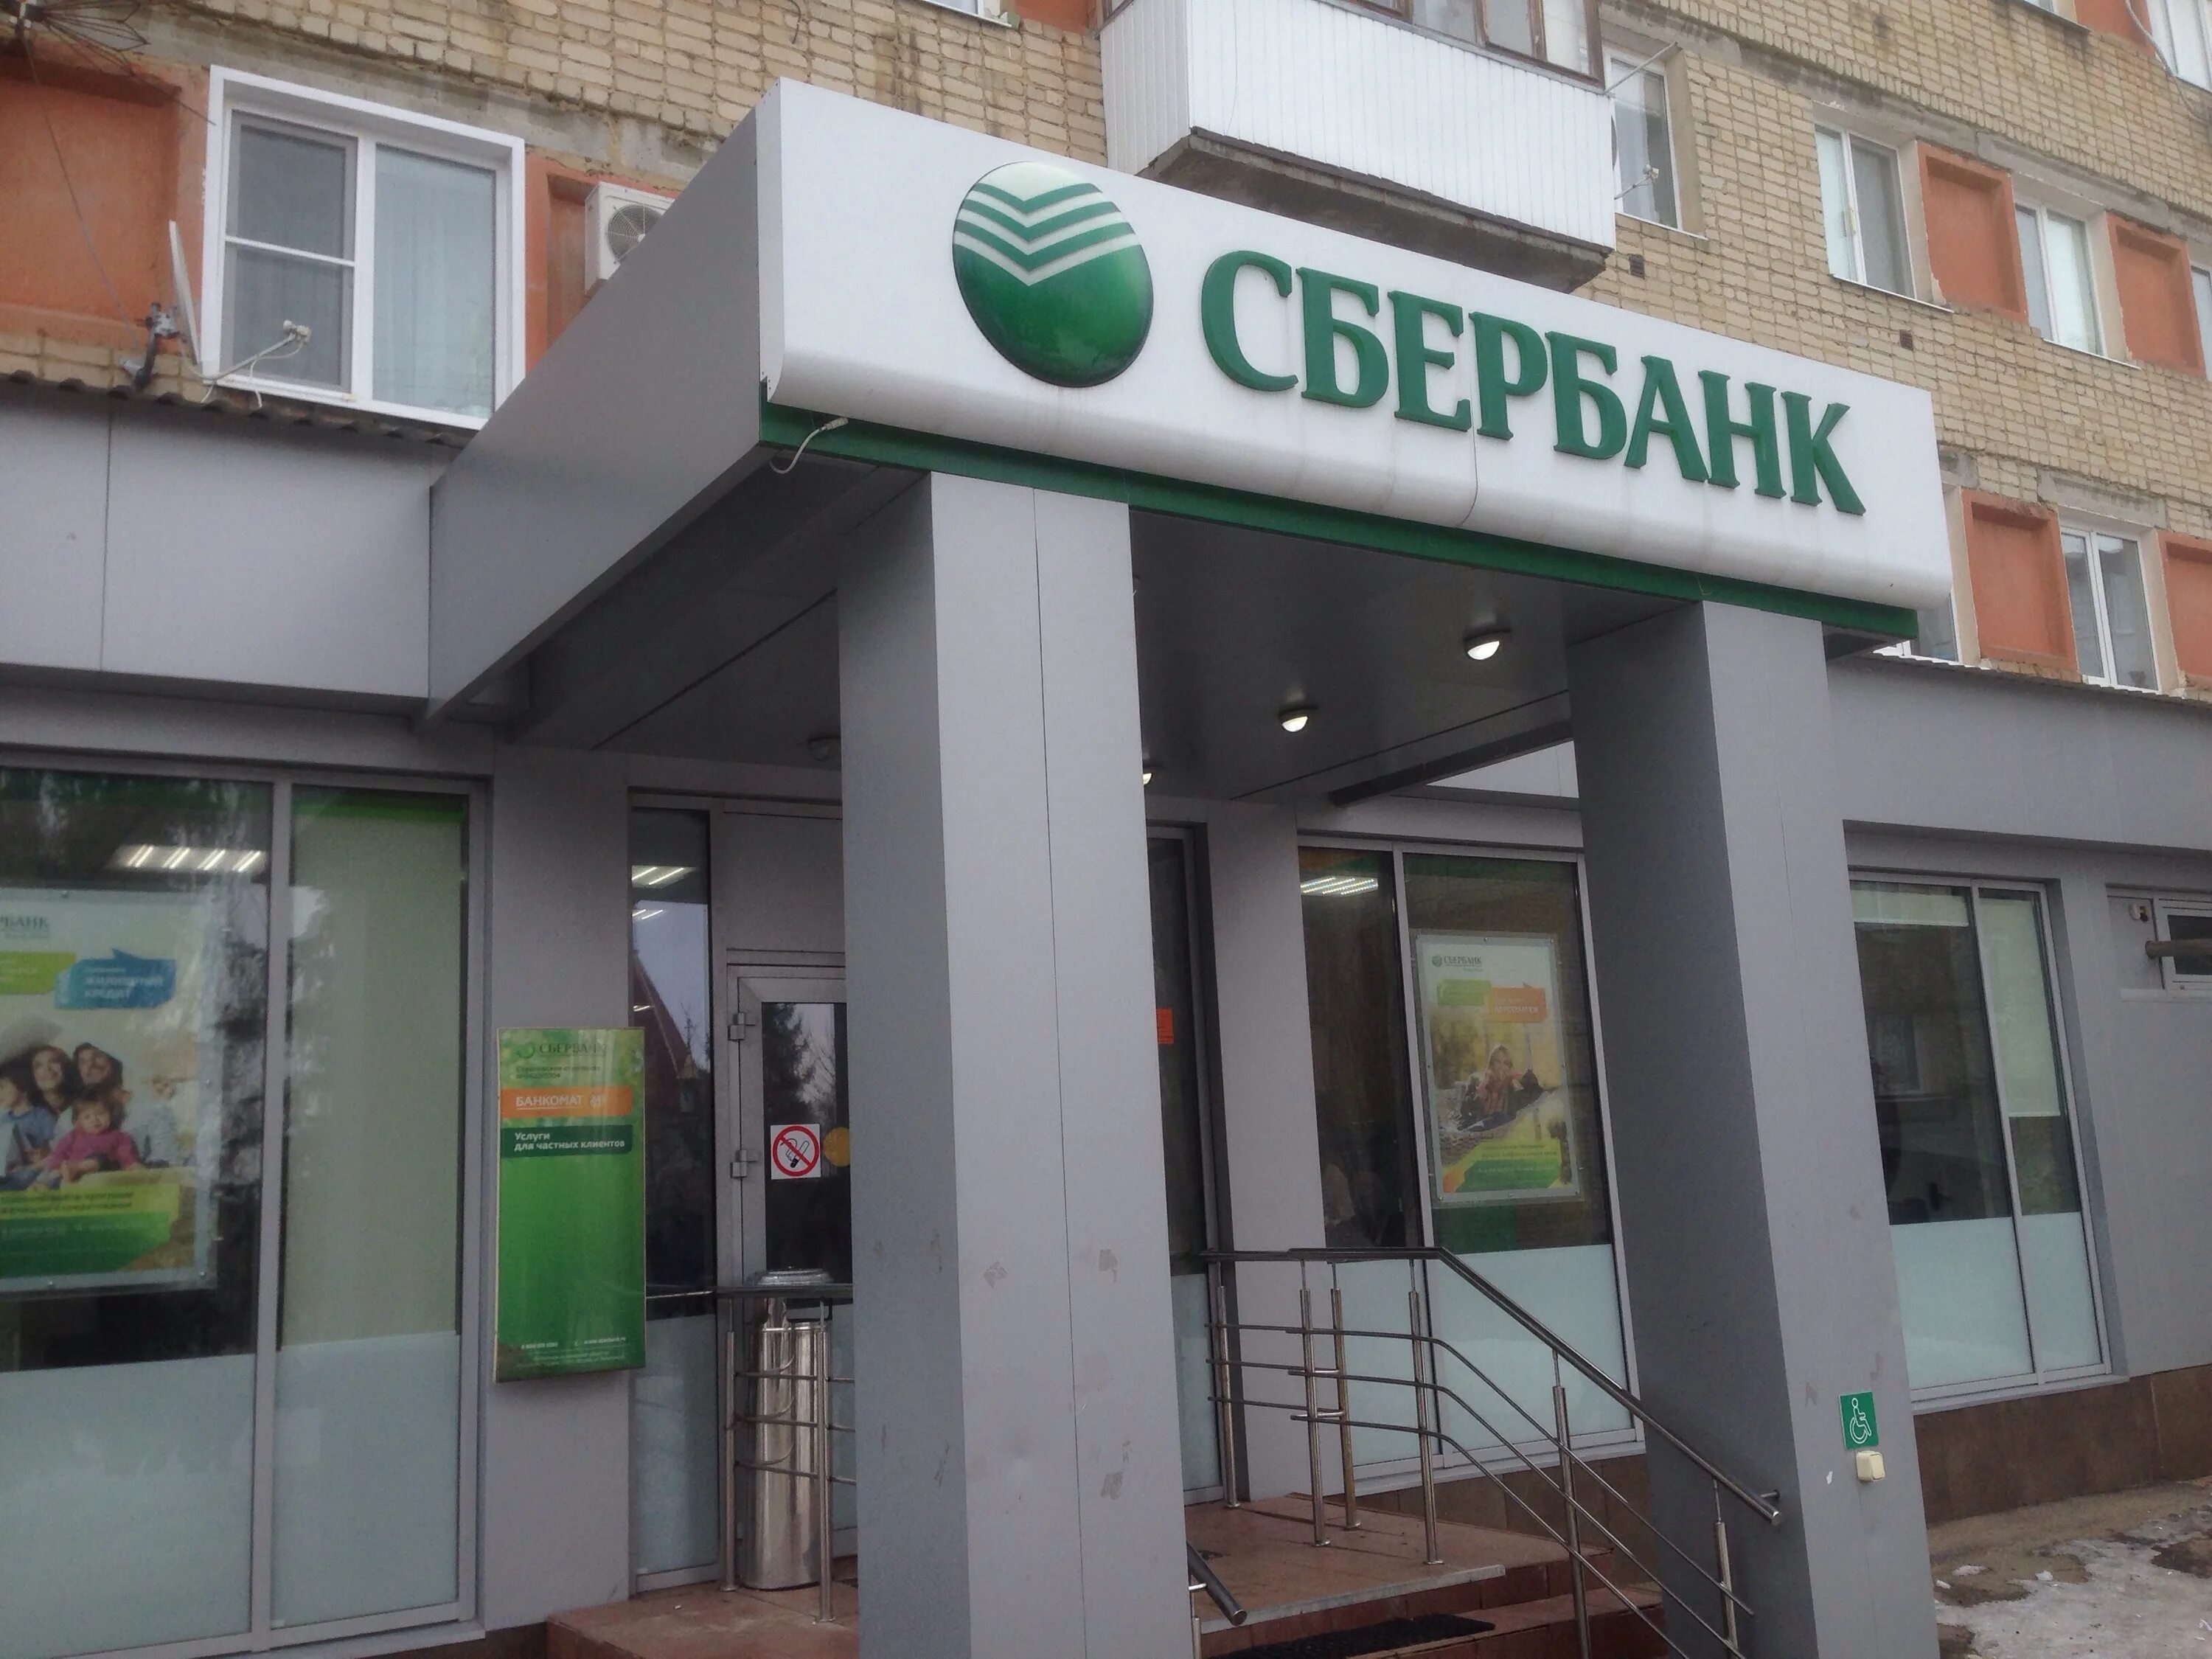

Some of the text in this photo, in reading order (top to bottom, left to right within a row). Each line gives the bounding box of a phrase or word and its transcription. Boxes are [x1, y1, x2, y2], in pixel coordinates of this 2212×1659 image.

[1201, 251, 1866, 515] СБЕРБАНК
[515, 1095, 584, 1107] БАНКОМАТ
[514, 1132, 550, 1142] Услуги
[514, 1140, 625, 1152] для частных клиентов
